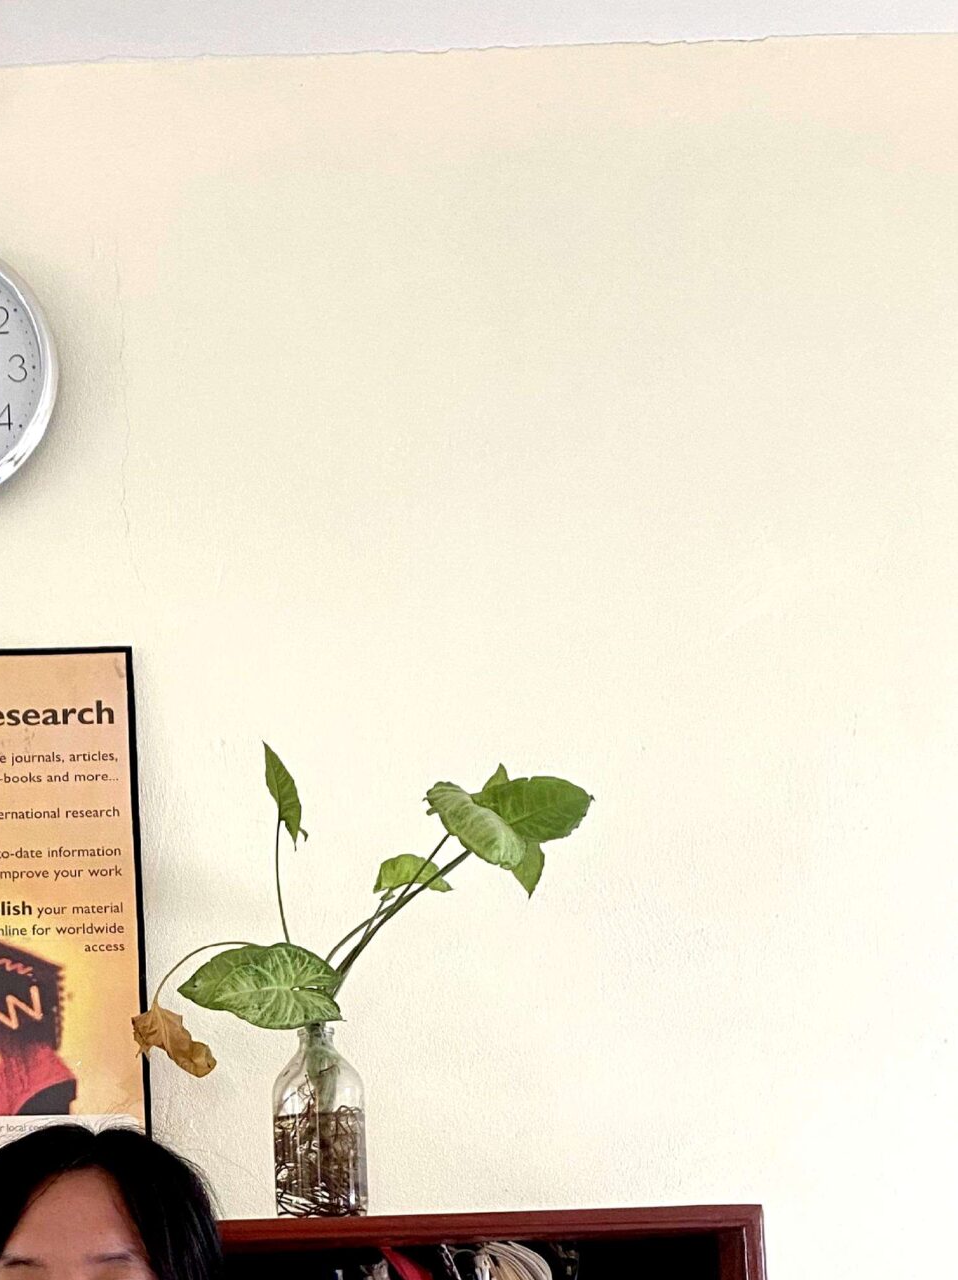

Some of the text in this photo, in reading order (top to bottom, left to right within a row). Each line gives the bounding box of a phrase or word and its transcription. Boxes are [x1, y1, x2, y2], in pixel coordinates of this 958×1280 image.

[7, 354, 28, 382] 3
[11, 752, 65, 766] journals,
[69, 751, 119, 764] articles,
[47, 772, 69, 783] and
[65, 806, 120, 818] research
[47, 846, 122, 858] information
[53, 868, 83, 880] your
[88, 866, 122, 877] work
[37, 904, 67, 917] your
[72, 902, 124, 914] material
[32, 924, 51, 935] for
[56, 922, 125, 934] worldwide
[85, 943, 125, 953] access
[6, 1124, 27, 1133] local
